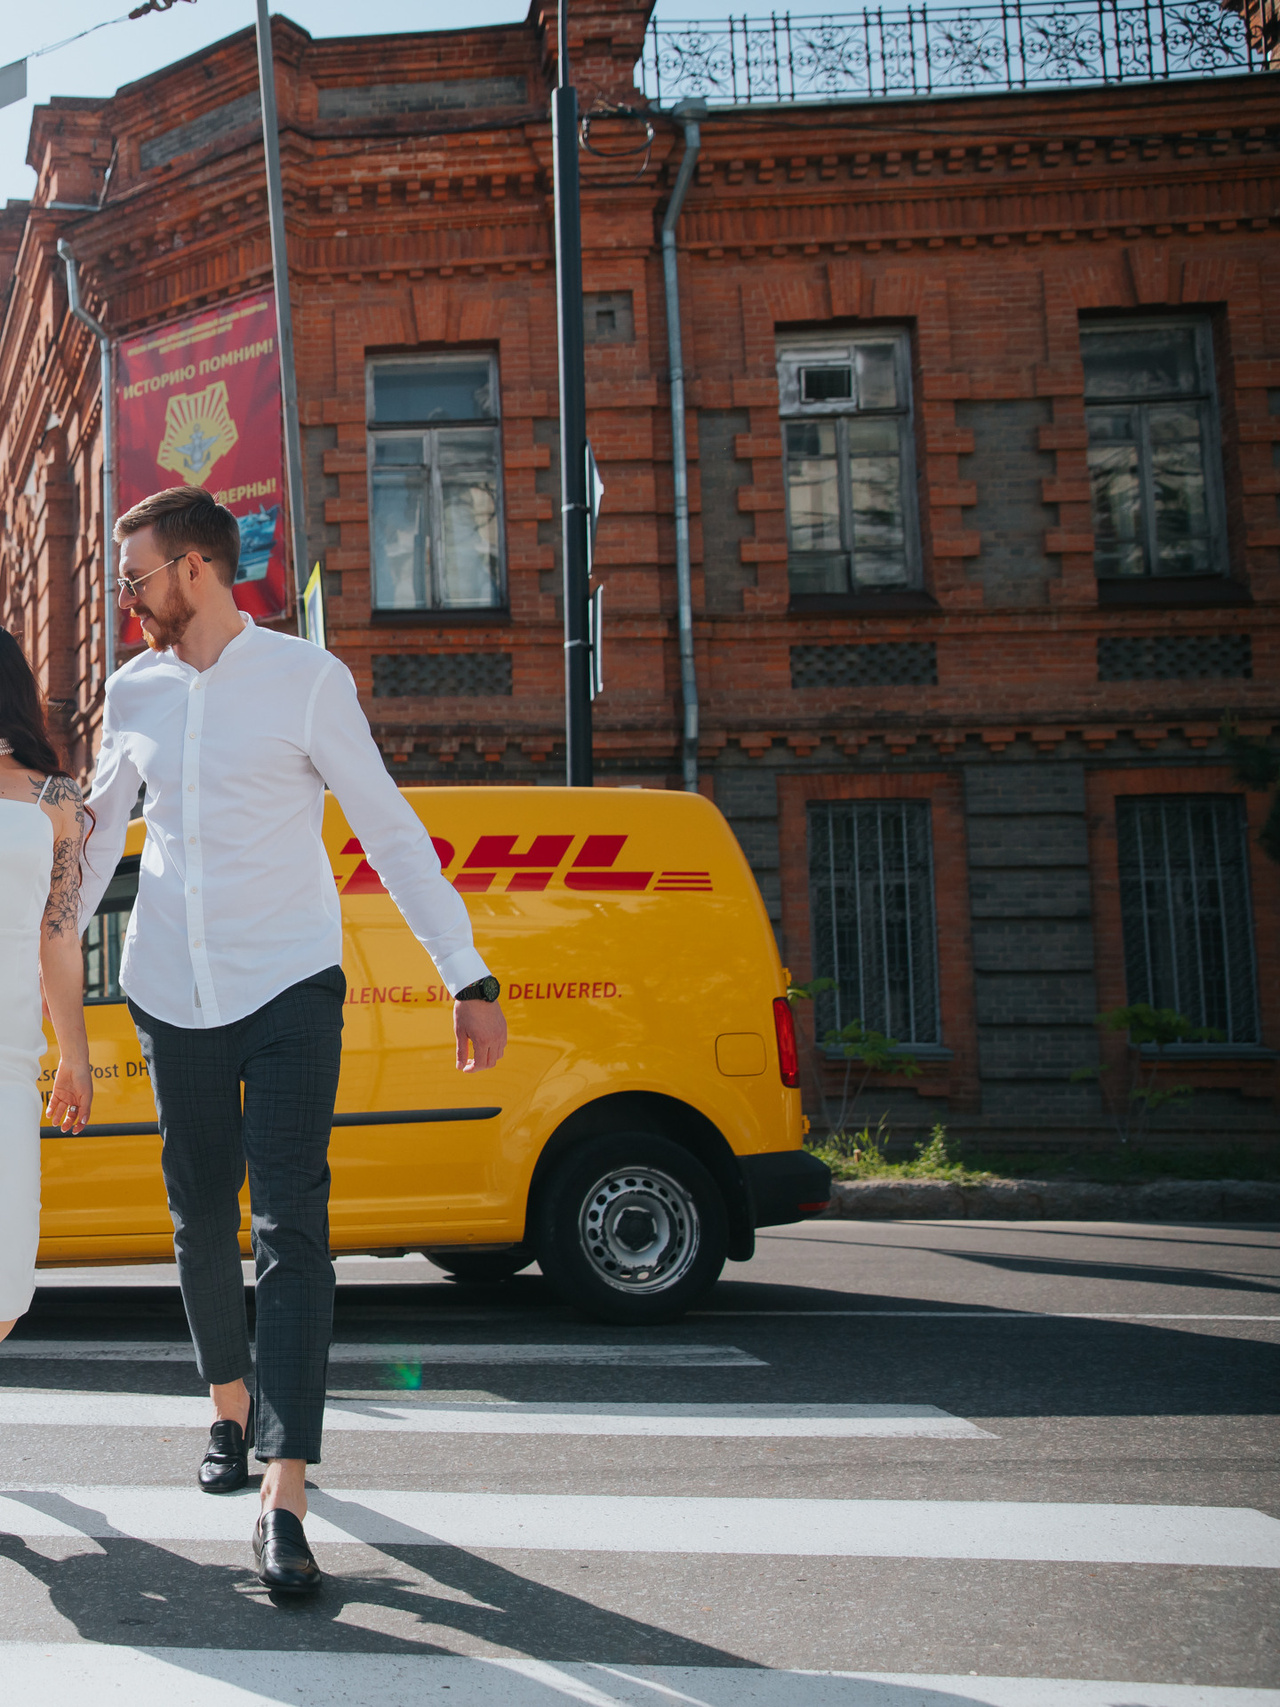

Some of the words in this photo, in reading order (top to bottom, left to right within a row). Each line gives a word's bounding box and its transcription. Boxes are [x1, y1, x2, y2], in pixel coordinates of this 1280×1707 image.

[123, 364, 196, 401] ИСТОРИЮ
[199, 338, 273, 376] ПОМНИМ!
[508, 982, 622, 1000] DELIVERED.
